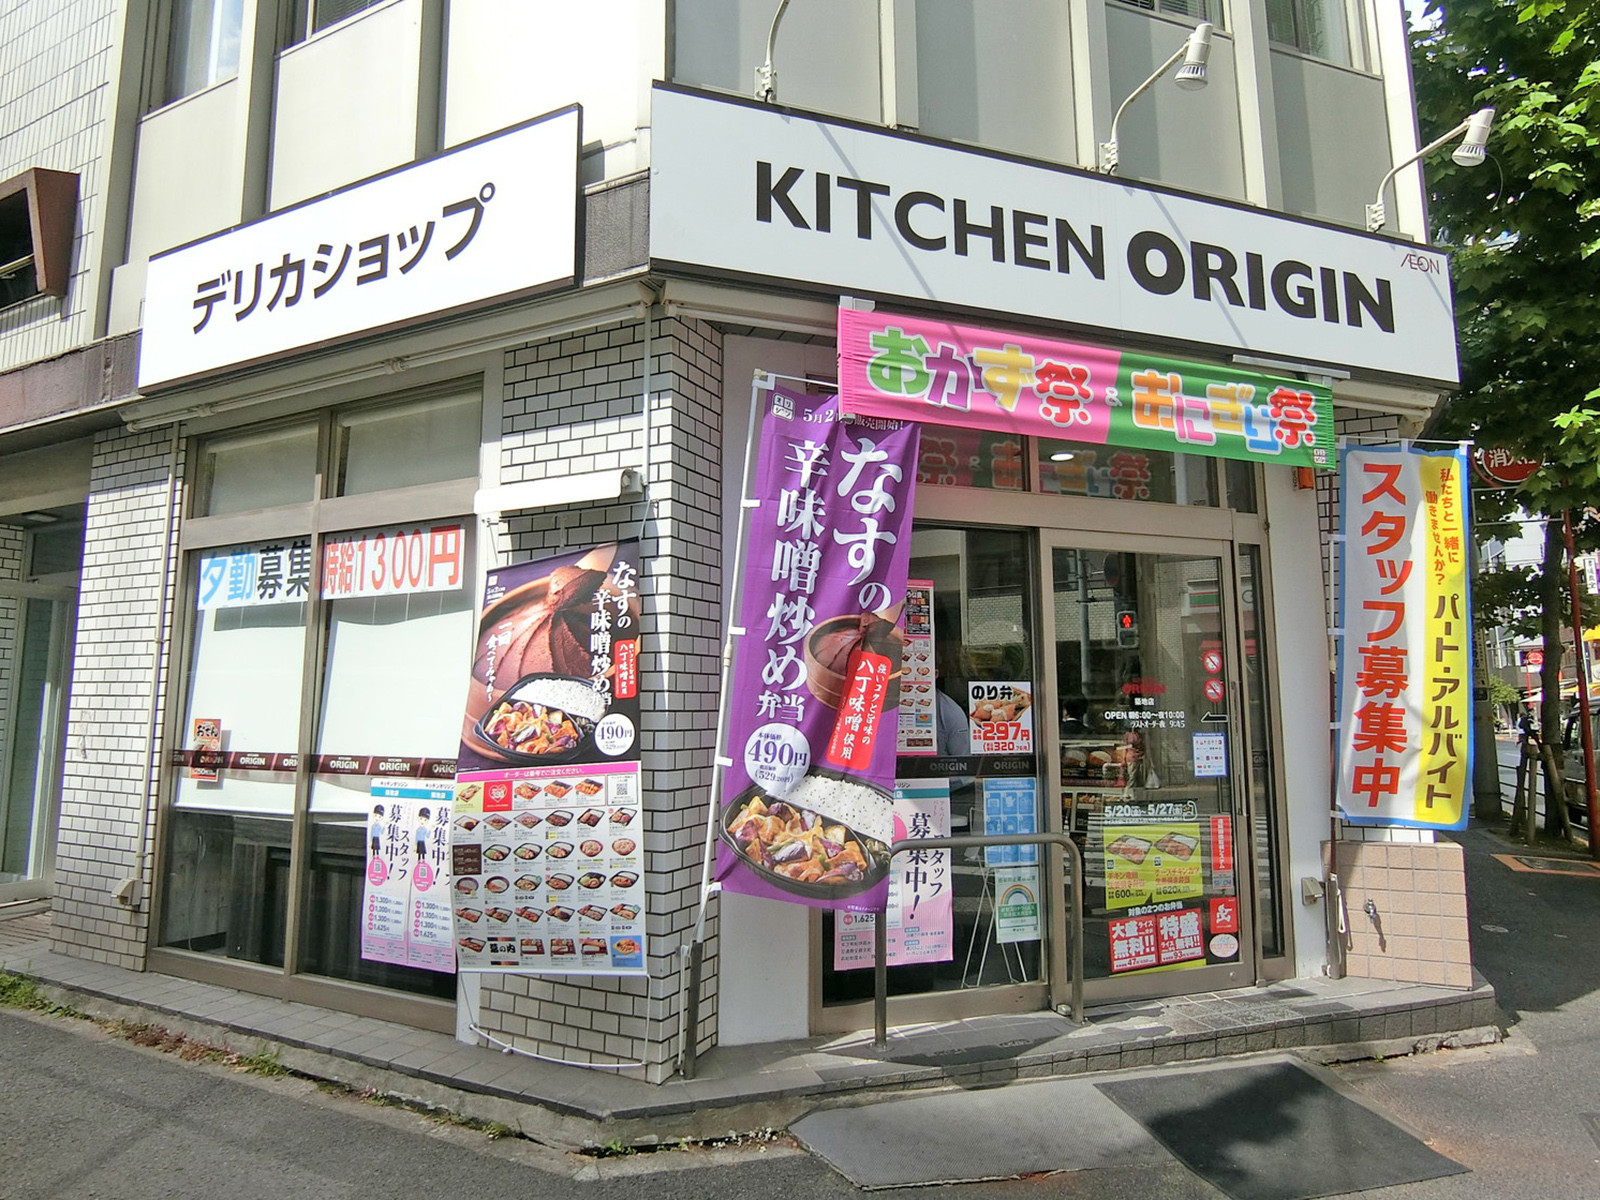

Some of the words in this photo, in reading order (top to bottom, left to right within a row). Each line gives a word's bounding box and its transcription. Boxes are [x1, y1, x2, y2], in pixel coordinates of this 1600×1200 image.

[193, 181, 496, 335] デリカショップ
[756, 160, 1106, 281] KITCHEN
[1126, 229, 1397, 334] ORIGIN
[866, 326, 1093, 427] おかず祭
[1131, 366, 1318, 454] おにぎり祭
[833, 437, 903, 613] なすの
[1425, 490, 1446, 585] 働きませんか?
[1440, 468, 1460, 563] 私たちと一緒に
[612, 561, 636, 629] なすの
[761, 440, 831, 691] 辛味噌炒め
[1352, 463, 1413, 808] スタッフ募集中
[756, 689, 805, 722] 弁当
[861, 663, 888, 745] 強いコクと旨味の
[971, 685, 1013, 700] のり弁
[1104, 711, 1127, 720] OPEN
[1425, 593, 1463, 808] パート・アルバイト
[239, 757, 265, 766] ORIGIN
[329, 760, 359, 770] ORIGIN
[379, 762, 410, 772] ORIGIN
[748, 739, 808, 766] 490円
[930, 762, 967, 771] ORIGIN
[993, 761, 1030, 771] ORIGIN
[399, 830, 410, 880] スタッフ
